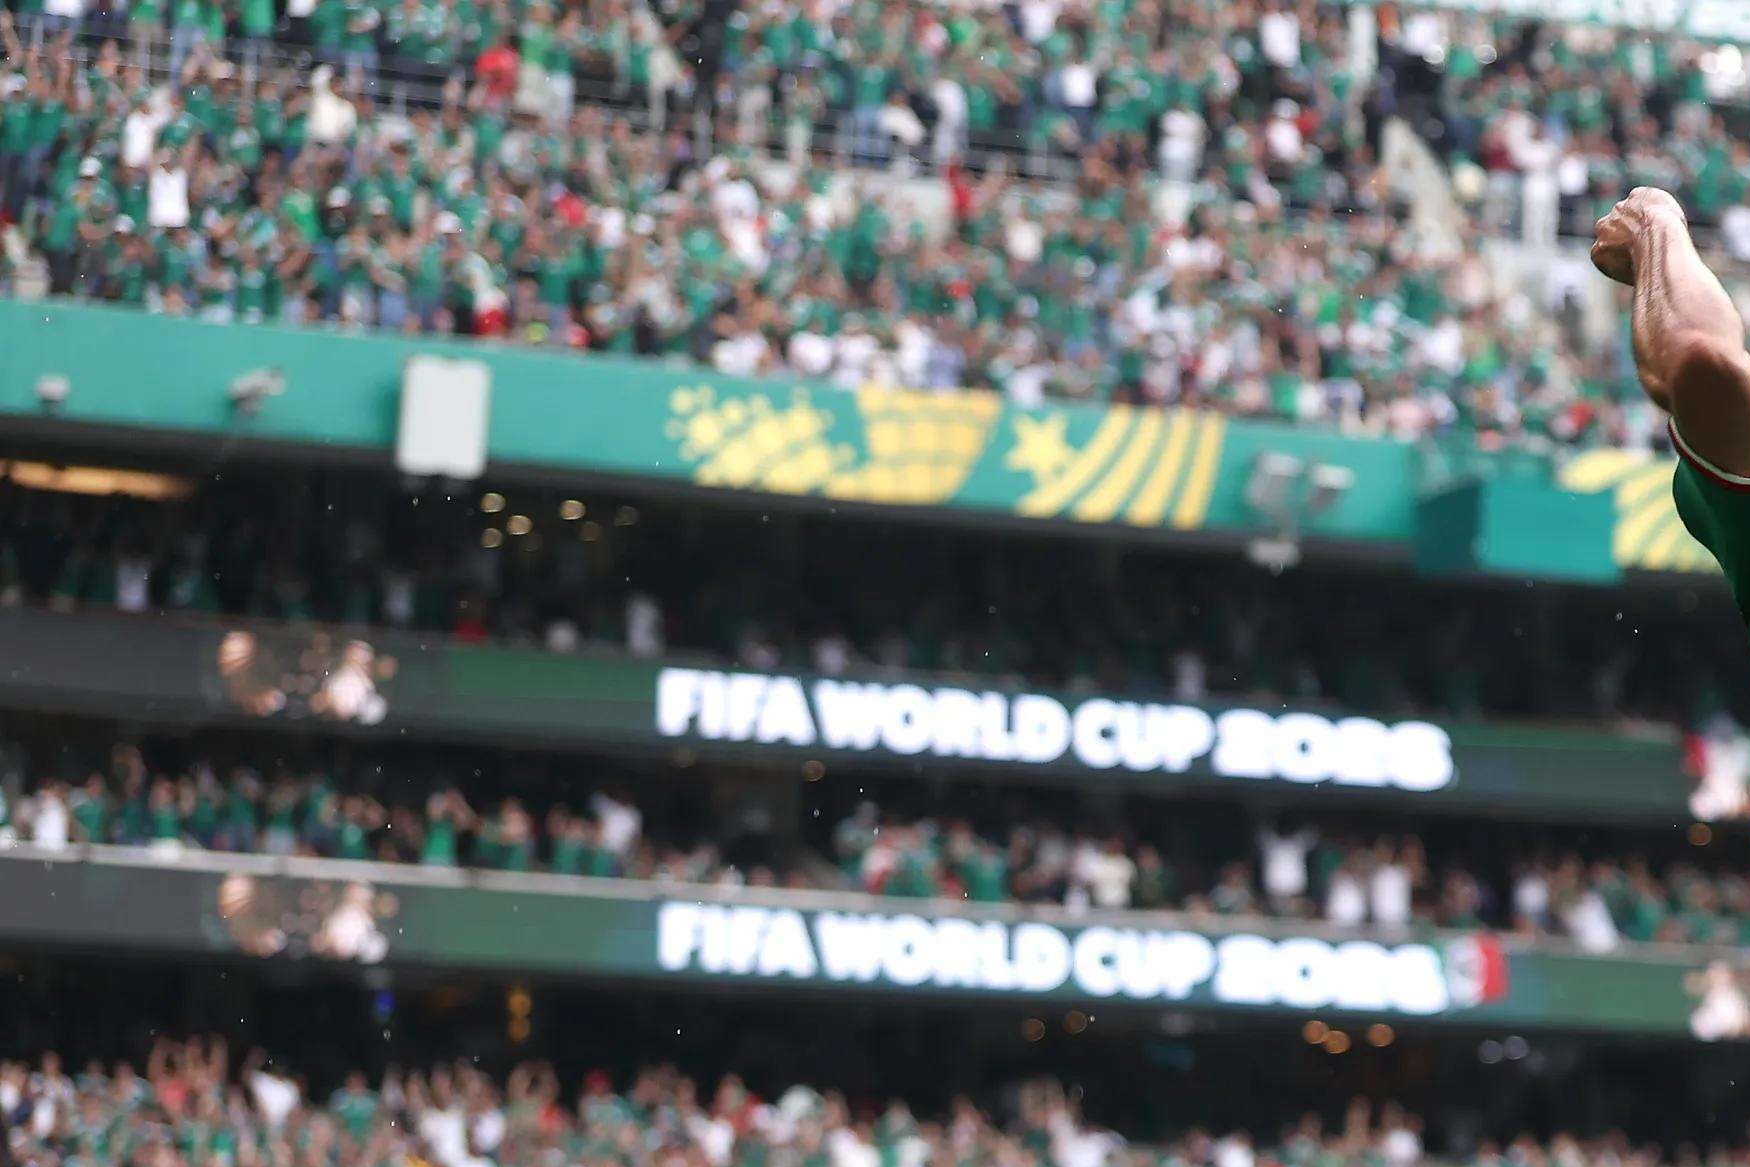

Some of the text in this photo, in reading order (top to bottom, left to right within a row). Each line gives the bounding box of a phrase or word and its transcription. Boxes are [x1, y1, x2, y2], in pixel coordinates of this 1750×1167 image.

[656, 668, 812, 746] FIFA
[815, 680, 1071, 763] WORLD
[1073, 699, 1213, 771] CUP
[657, 903, 814, 977] FIFA
[817, 912, 1072, 992] WORLD
[1074, 926, 1213, 998] CUP
